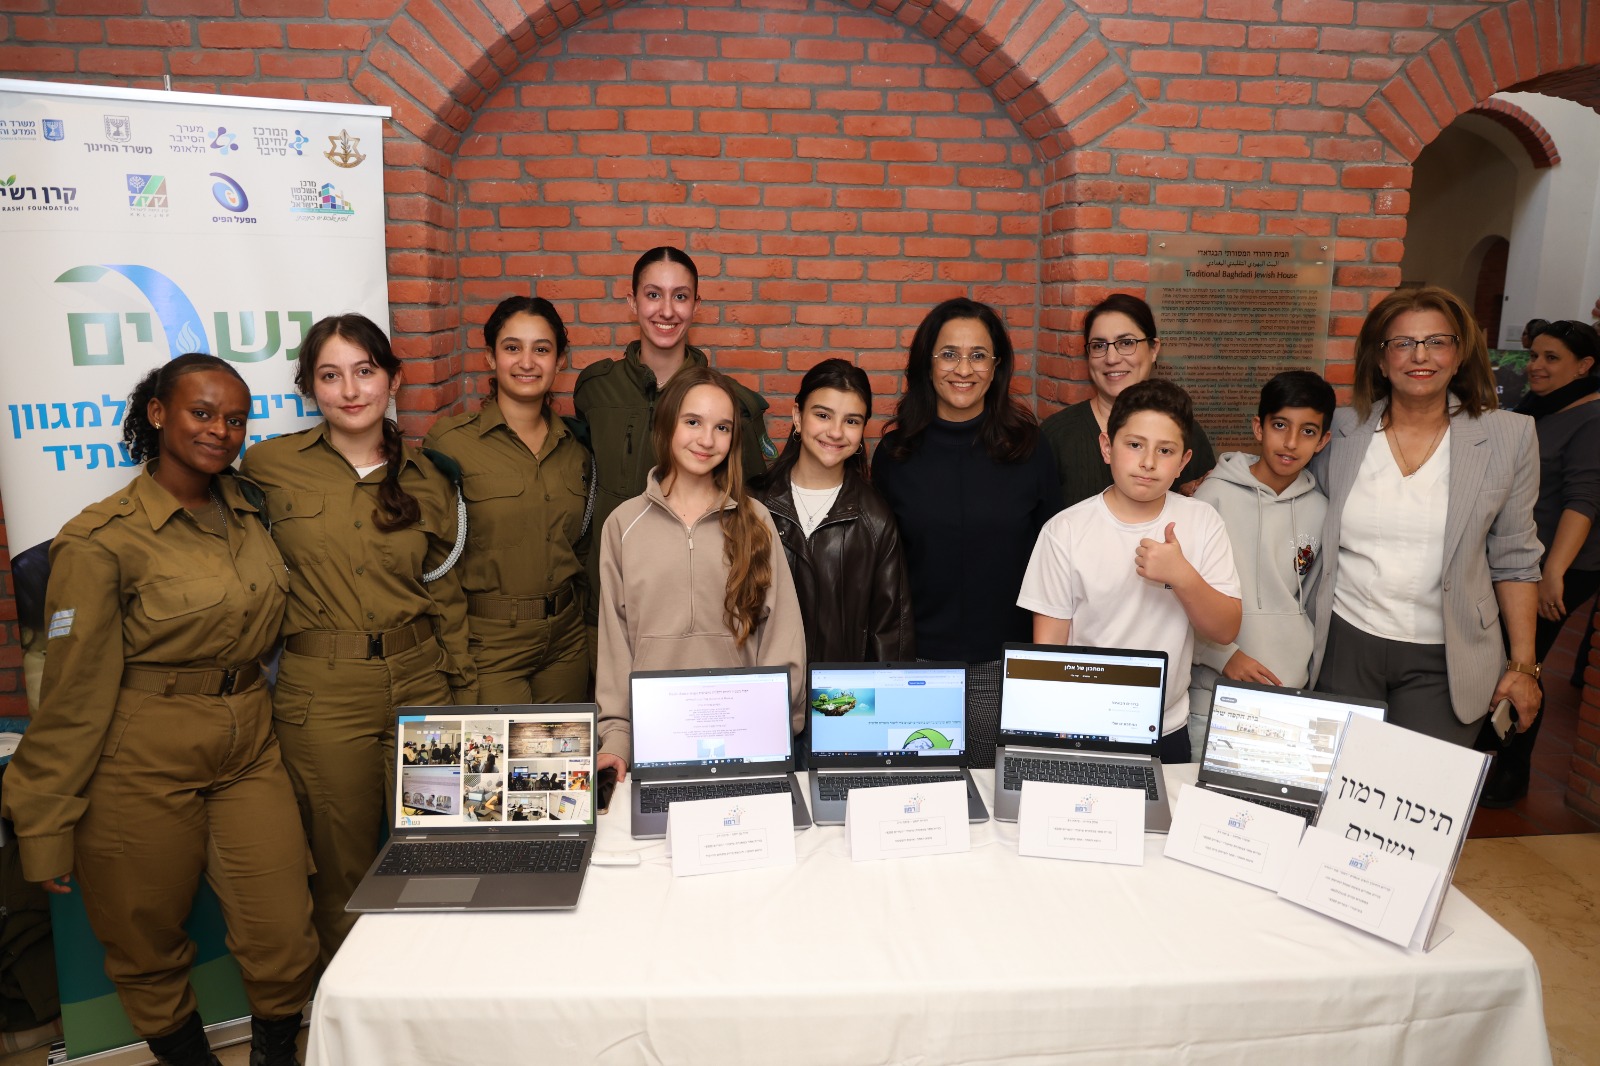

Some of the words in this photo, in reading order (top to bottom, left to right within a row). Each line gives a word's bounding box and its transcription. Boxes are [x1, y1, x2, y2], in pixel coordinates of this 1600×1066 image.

[176, 124, 204, 133] מערך
[252, 127, 288, 137] המרכז
[169, 134, 205, 143] הסייבר
[253, 136, 288, 147] לחינוך
[83, 142, 119, 153] החינוך
[121, 144, 153, 155] משרד
[169, 144, 206, 154] הלאומי
[257, 147, 287, 156] סייבר
[42, 186, 77, 204] קרן
[233, 216, 257, 224] מפעל
[1185, 269, 1221, 278] Traditional
[1222, 269, 1253, 280] Baghdadi
[1254, 270, 1276, 279] Jewish
[1276, 271, 1298, 279] House
[8, 393, 128, 440] למגוון
[43, 441, 143, 472] עתיד
[1337, 775, 1386, 810] רמון
[1392, 795, 1454, 836] תיכון
